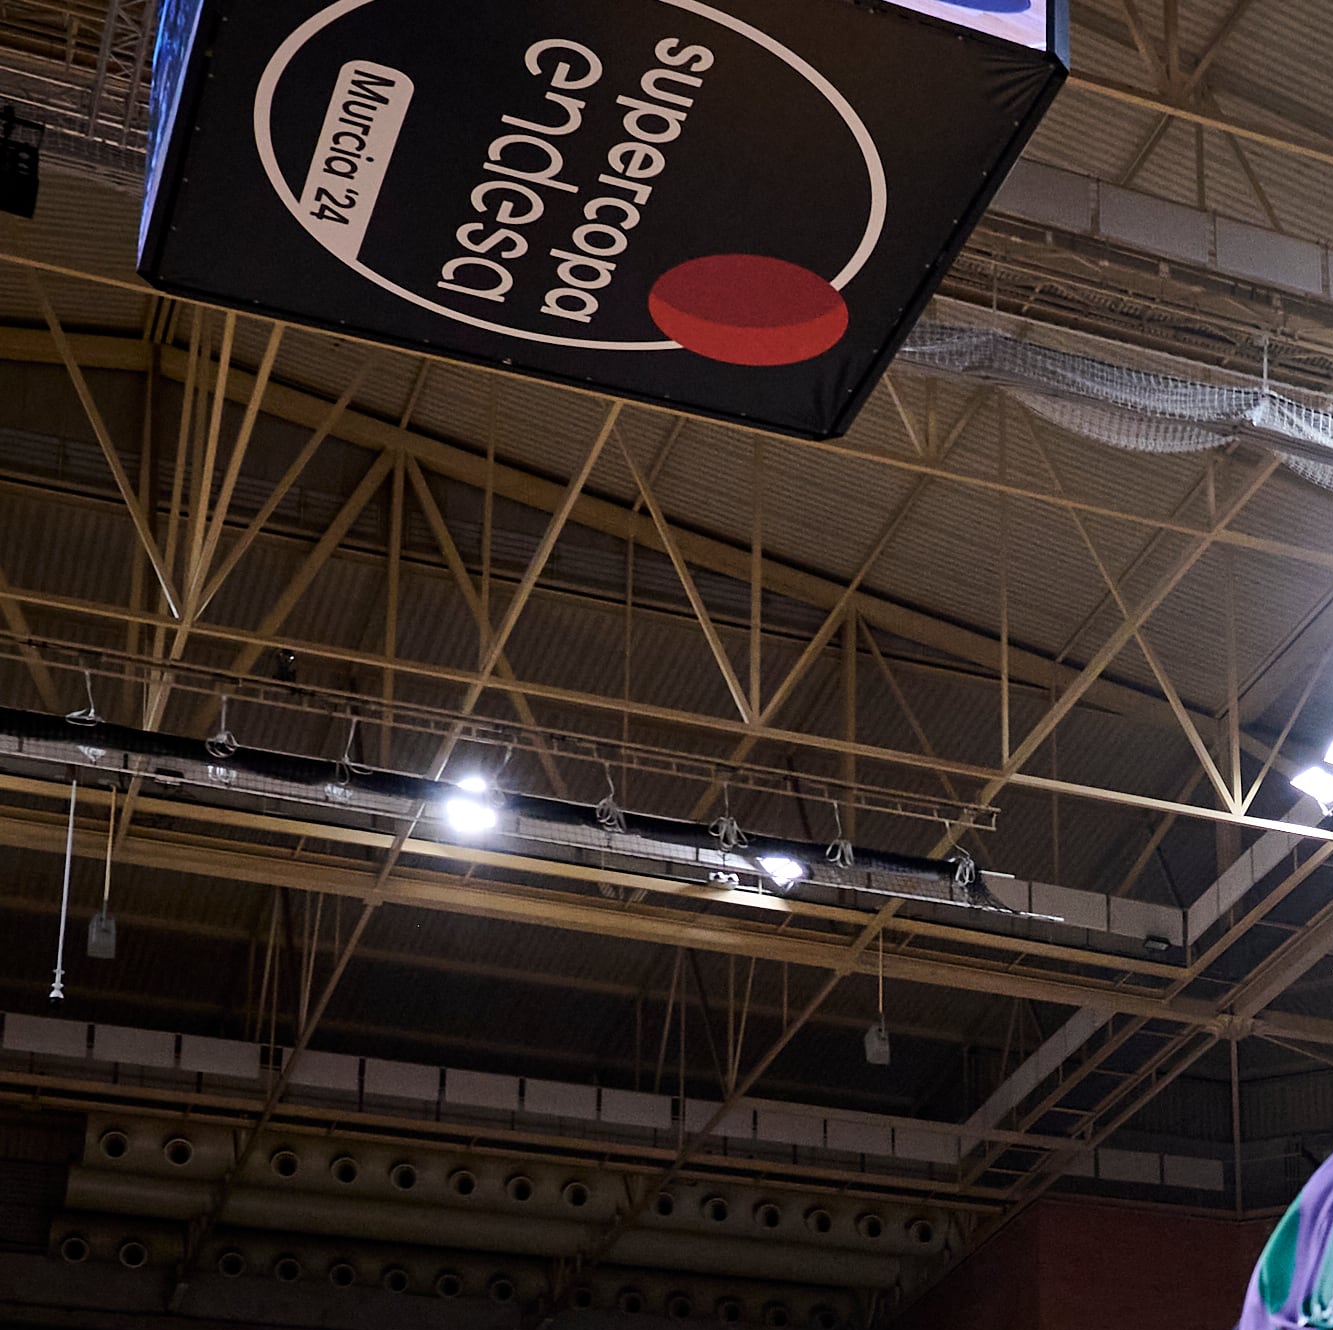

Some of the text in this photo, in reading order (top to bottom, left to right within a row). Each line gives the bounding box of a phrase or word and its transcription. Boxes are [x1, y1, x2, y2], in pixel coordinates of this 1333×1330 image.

[309, 69, 396, 226] Murcia '24
[437, 38, 603, 302] endesa
[540, 37, 715, 323] supercopa
